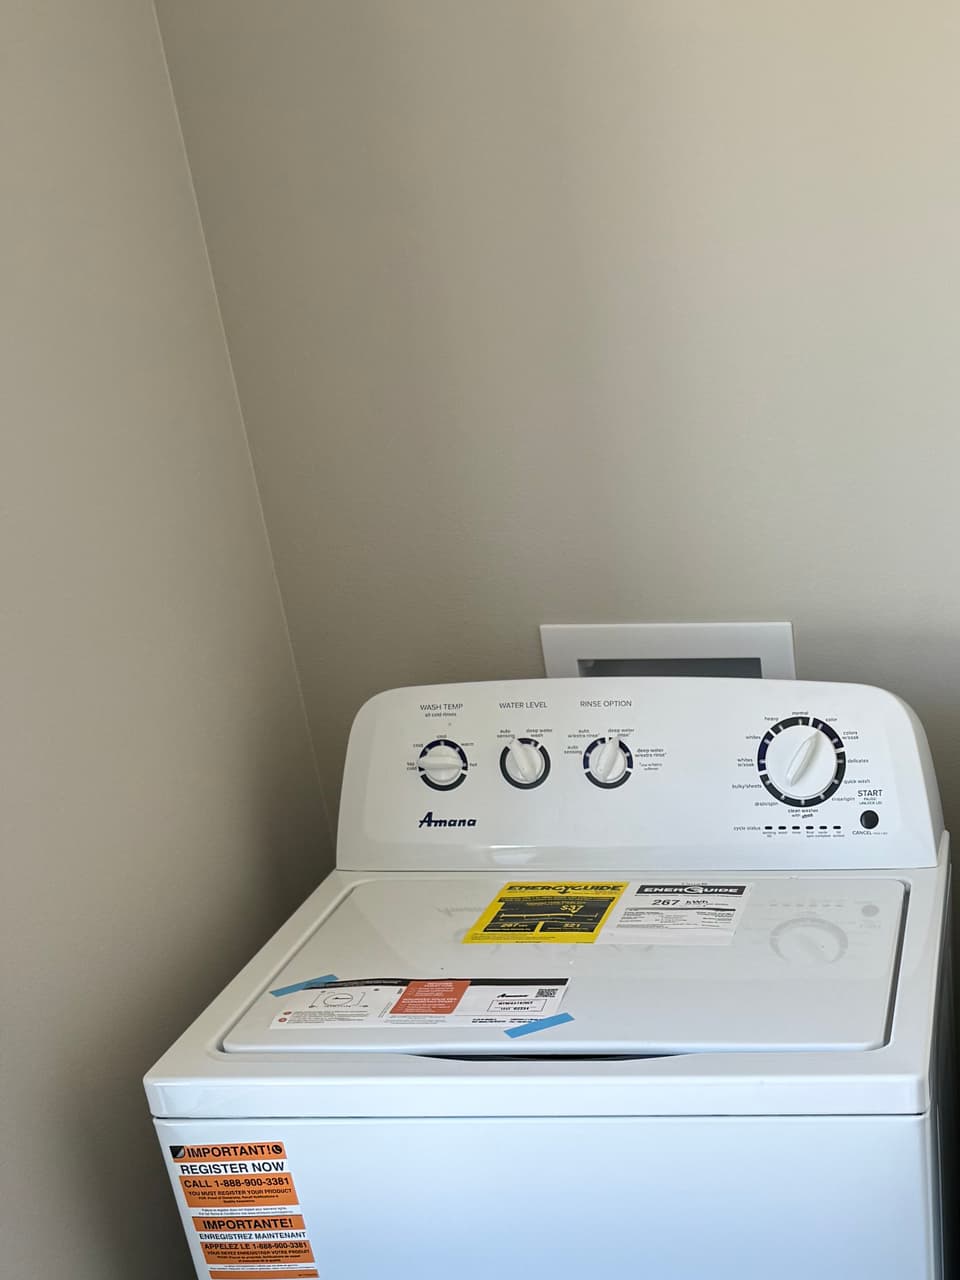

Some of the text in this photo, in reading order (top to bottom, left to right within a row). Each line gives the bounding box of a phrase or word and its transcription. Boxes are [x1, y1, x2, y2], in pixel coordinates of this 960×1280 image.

[418, 811, 478, 828] Amana
[186, 1145, 270, 1158] IMPORTANT!
[180, 1162, 284, 1174] REGISTER NOW
[184, 1177, 289, 1188] CALL 1-888-900-3381
[203, 1218, 293, 1230] IMPORTANTE!
